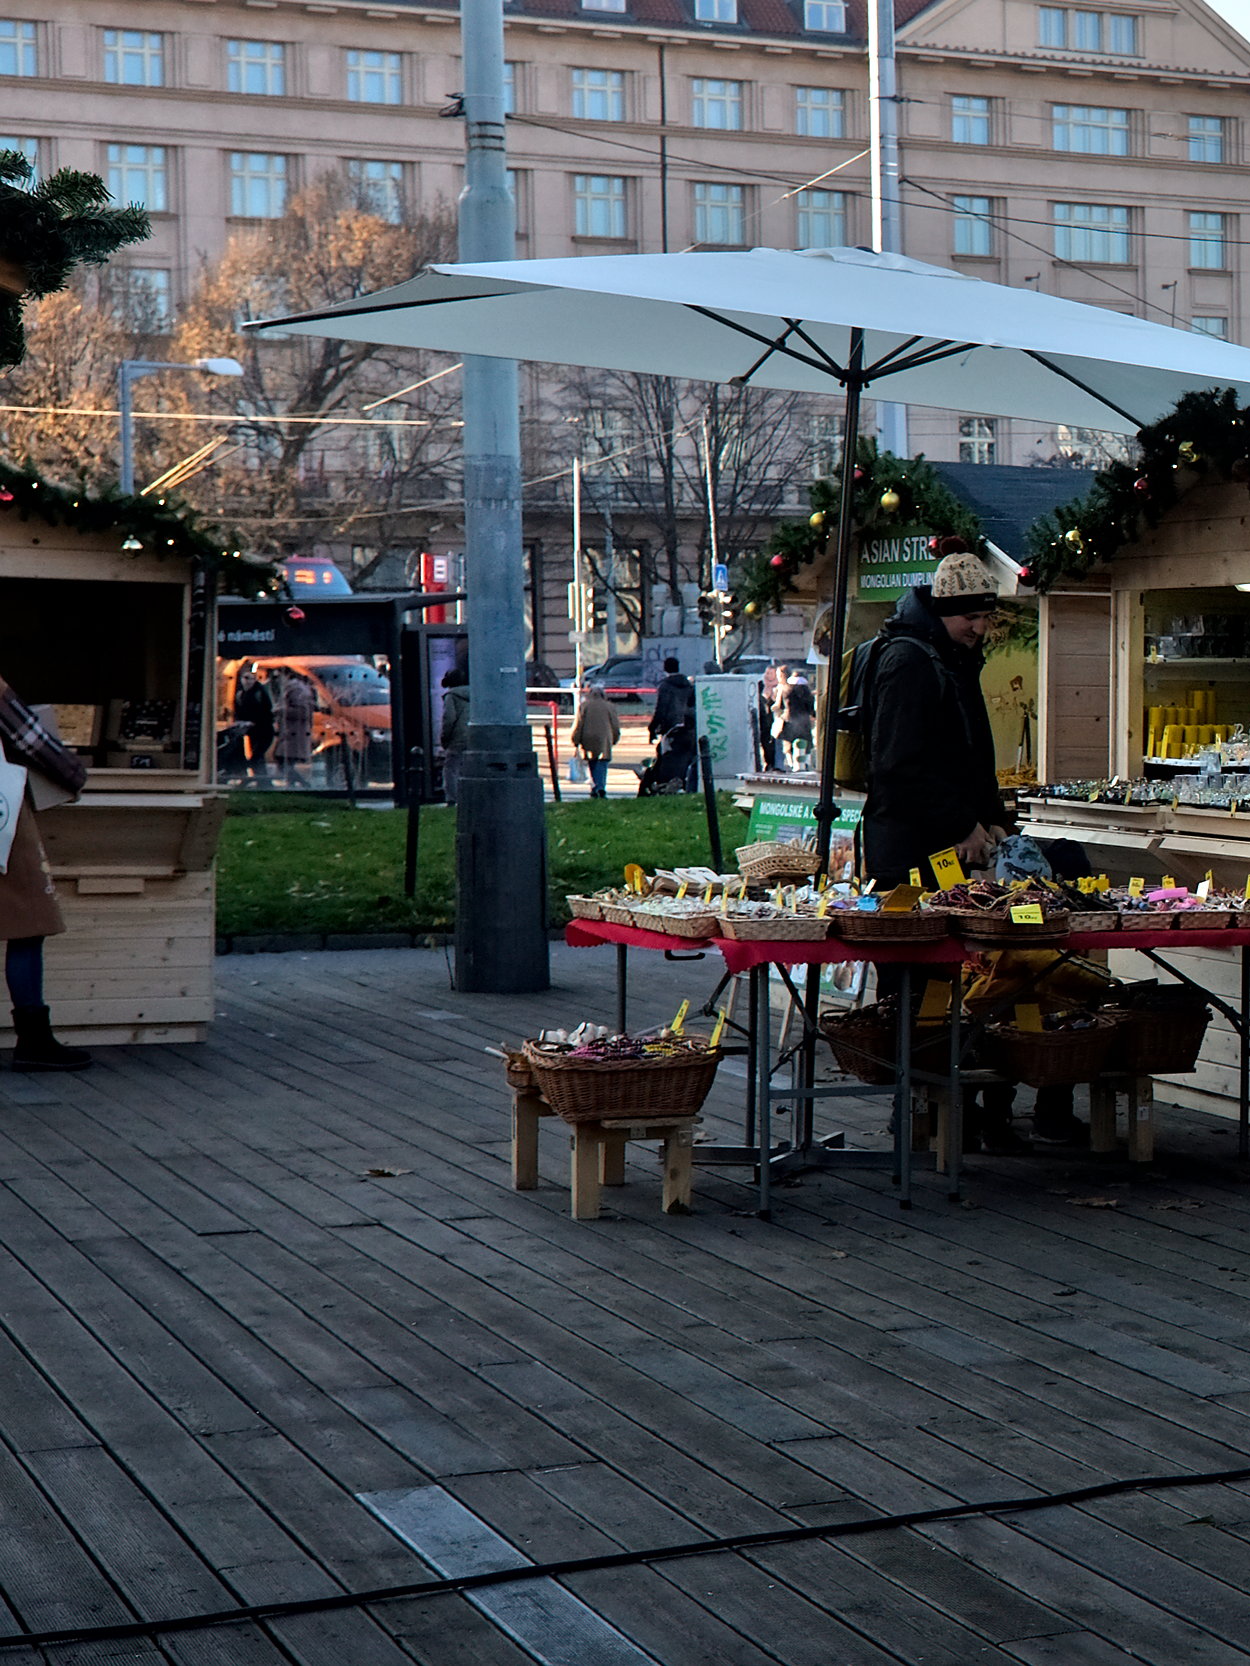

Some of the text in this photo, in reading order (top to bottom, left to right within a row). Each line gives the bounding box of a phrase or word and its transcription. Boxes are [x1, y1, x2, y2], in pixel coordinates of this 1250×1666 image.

[861, 538, 900, 564] ASIAN
[860, 573, 901, 589] MONGOLIAN
[760, 801, 804, 818] MONGOLSKÉ
